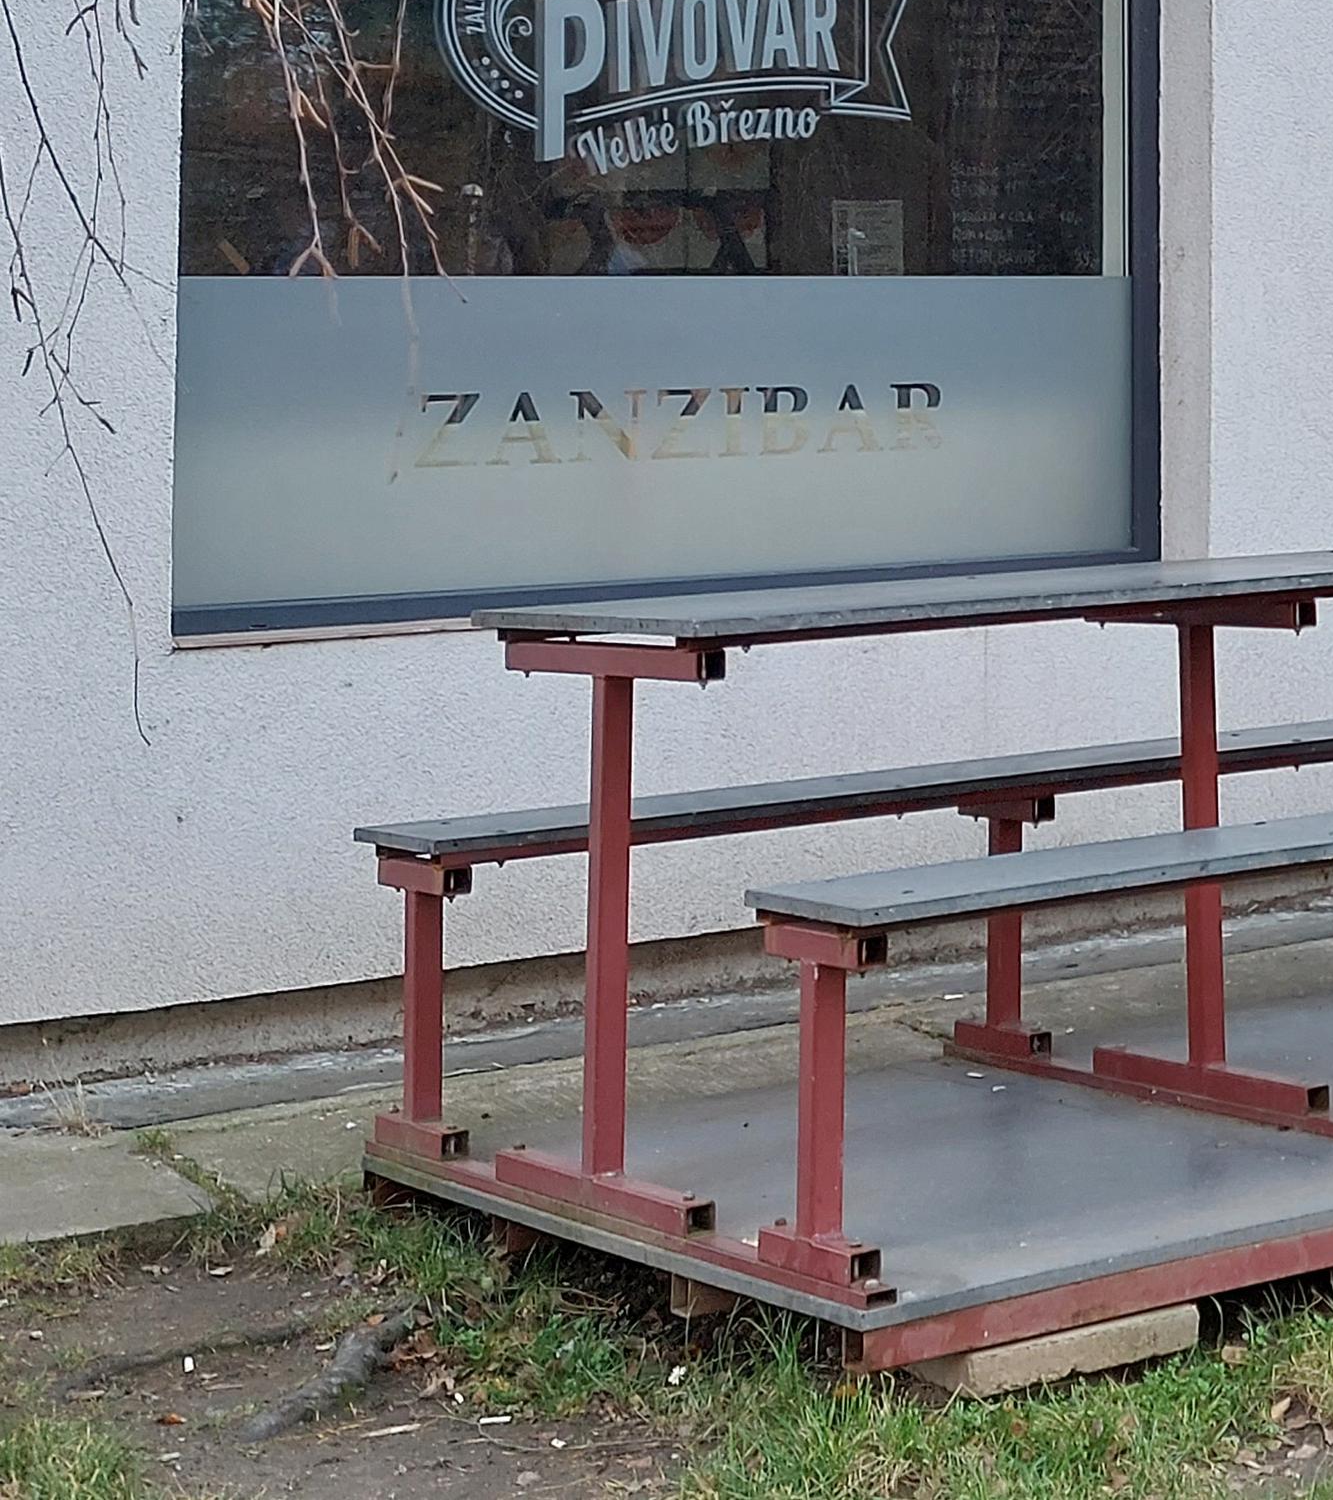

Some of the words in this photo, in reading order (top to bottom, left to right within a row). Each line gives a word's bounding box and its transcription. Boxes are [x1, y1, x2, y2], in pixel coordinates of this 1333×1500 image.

[576, 106, 680, 176] Velké
[687, 98, 822, 148] Březno
[414, 381, 946, 467] ZANZIBAR
